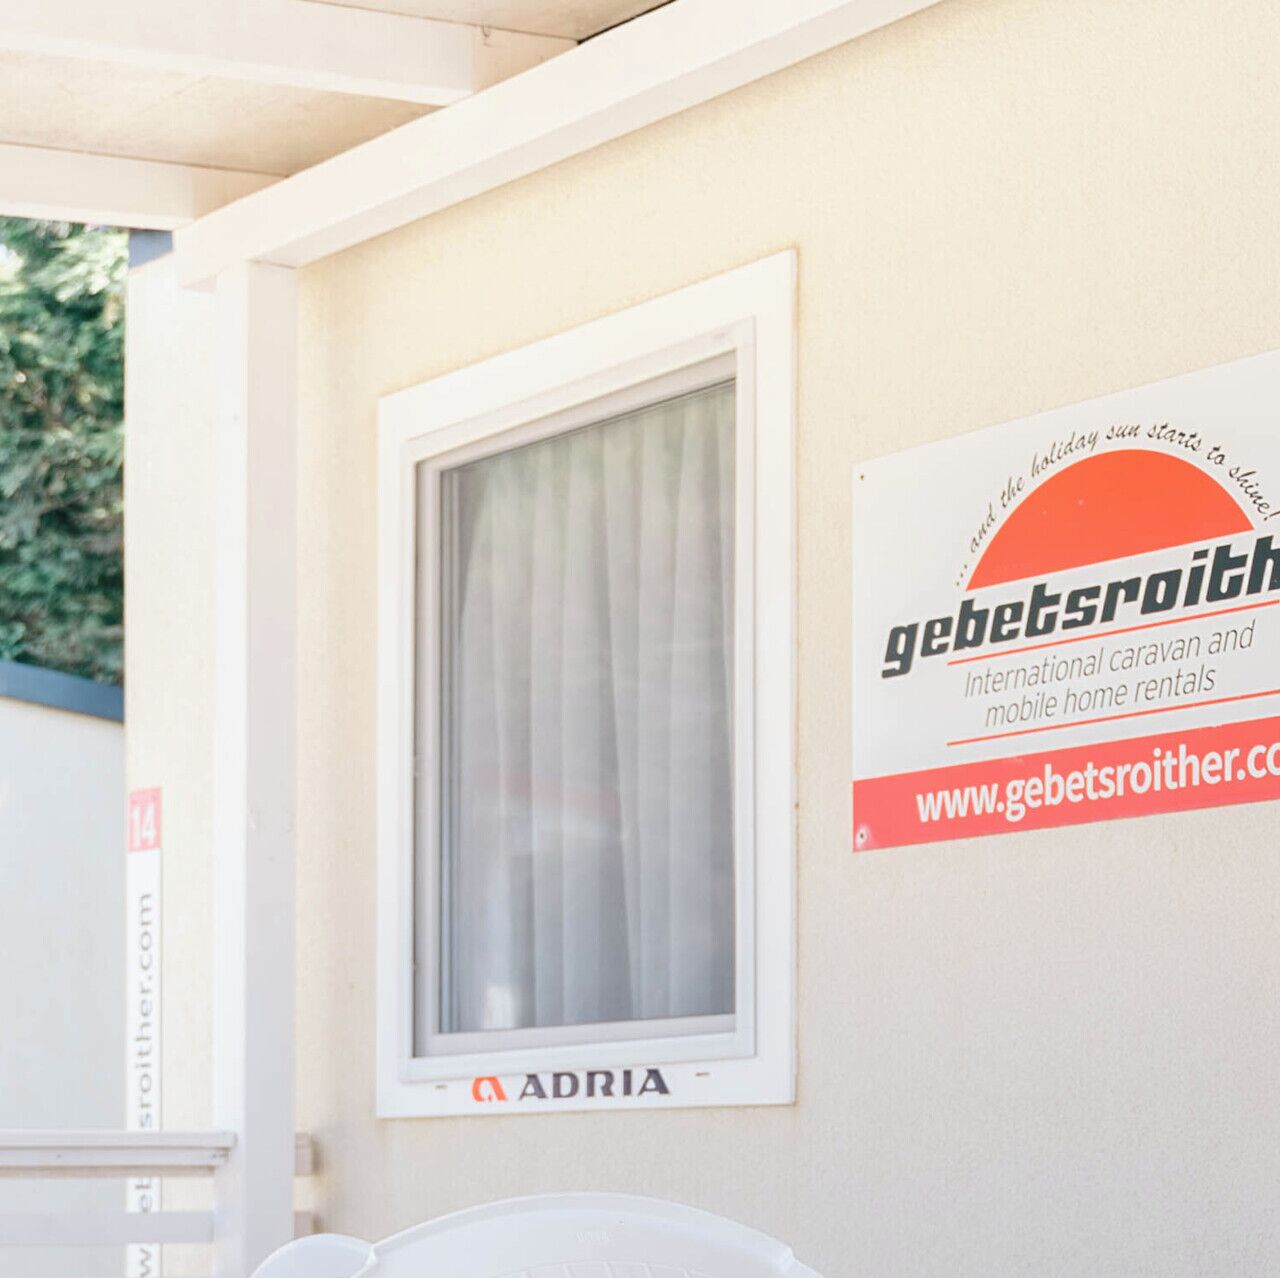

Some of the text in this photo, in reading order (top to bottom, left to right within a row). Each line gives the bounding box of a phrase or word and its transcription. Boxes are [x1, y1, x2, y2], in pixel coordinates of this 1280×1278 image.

[970, 500, 998, 554] and
[1000, 476, 1025, 509] the
[1031, 431, 1099, 479] holiday
[1106, 423, 1141, 441] sun
[1147, 422, 1203, 452] starts
[1206, 445, 1226, 466] to
[964, 618, 1256, 699] International caravan and
[985, 663, 1217, 729] mobile home rentals
[133, 803, 156, 848] 14
[518, 1068, 671, 1101] ADRIA
